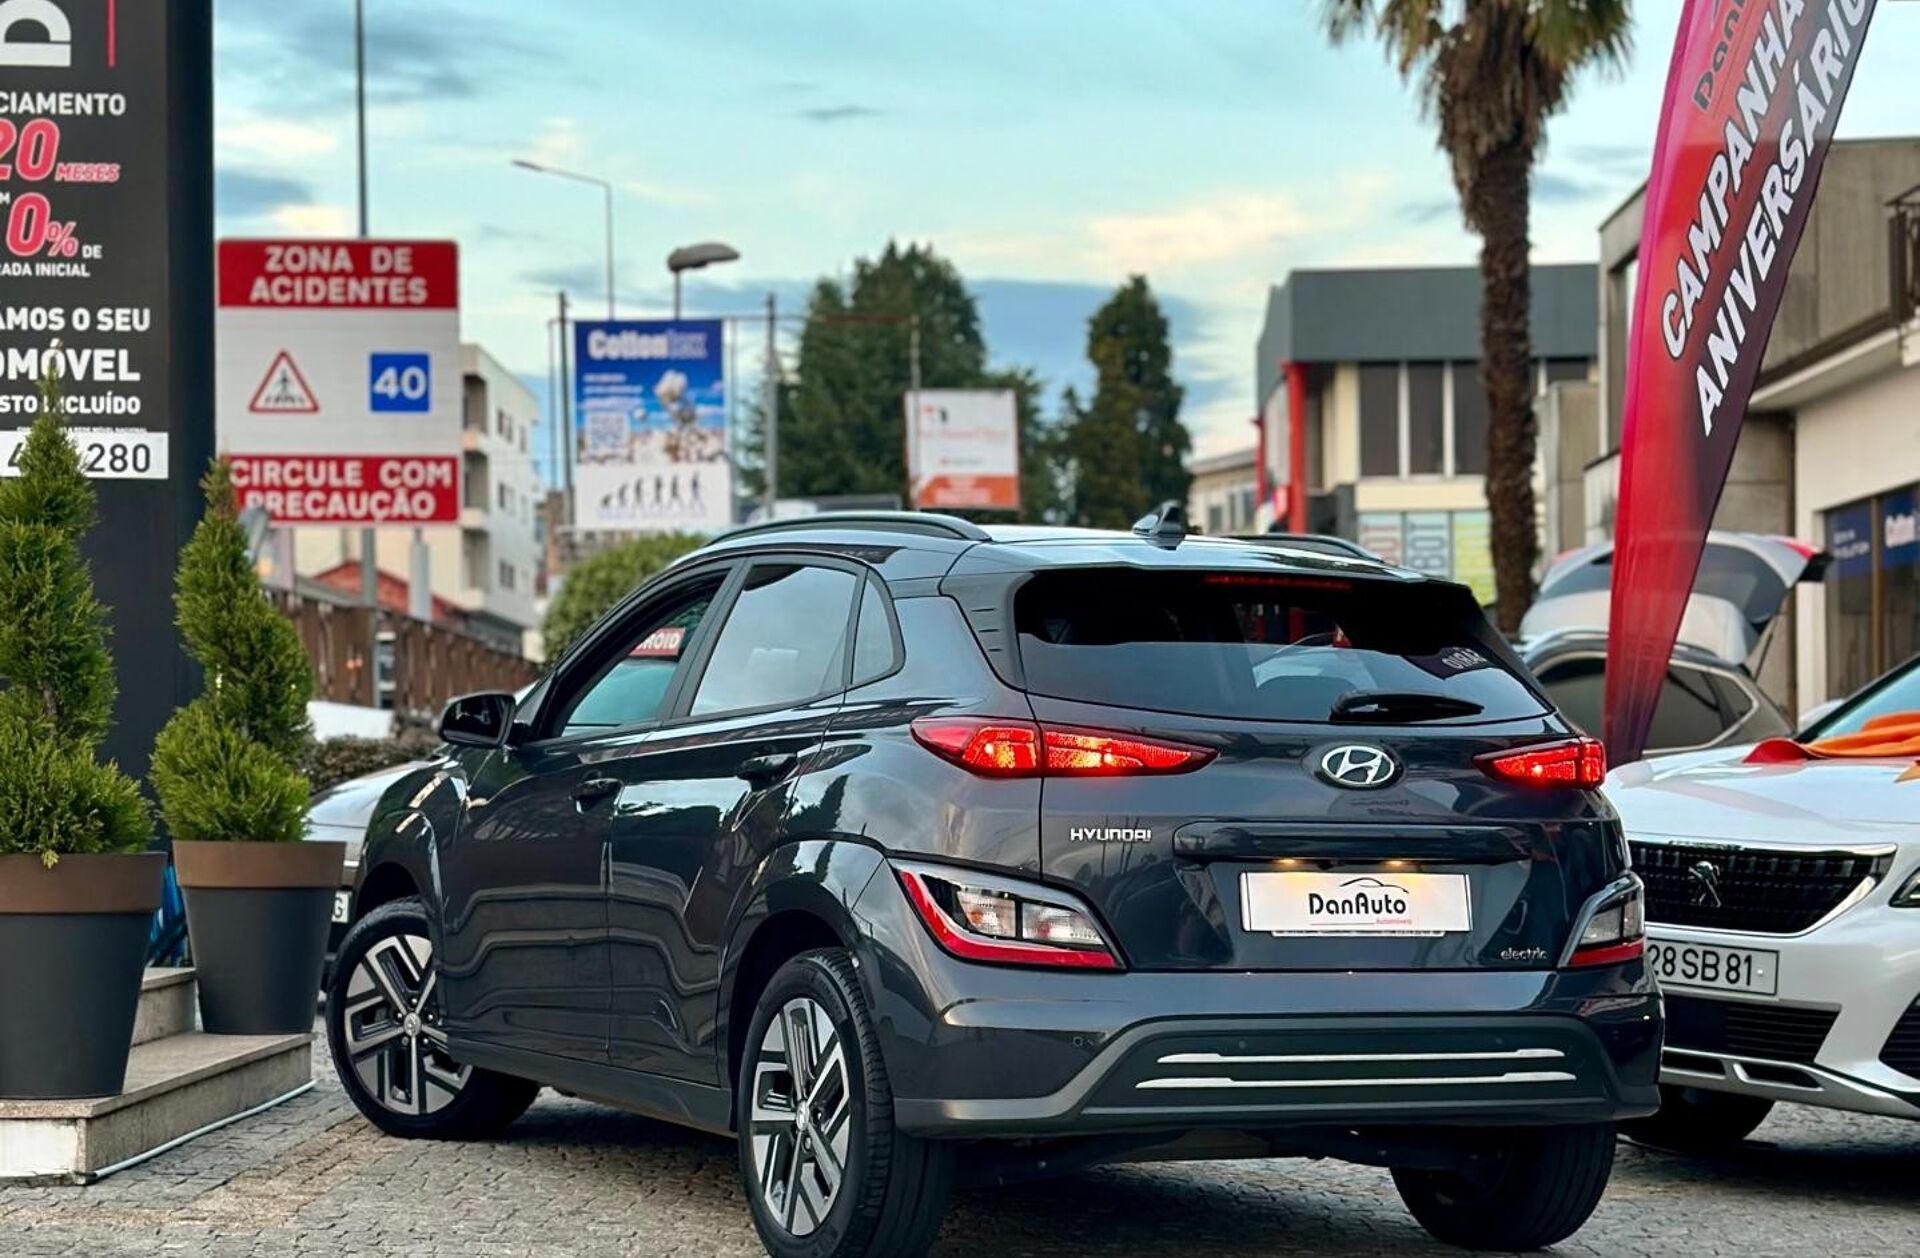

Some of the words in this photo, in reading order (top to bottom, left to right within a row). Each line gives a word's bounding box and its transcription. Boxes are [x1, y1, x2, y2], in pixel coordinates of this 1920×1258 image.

[1693, 0, 1748, 111] Dan
[55, 162, 121, 181] MESES
[1663, 0, 1805, 358] CAMPANHA
[82, 244, 102, 258] DE
[265, 246, 353, 273] ZONA
[371, 247, 413, 273] DE
[0, 262, 33, 276] ADA
[35, 263, 91, 277] INICIAL
[249, 276, 428, 303] ACIDENTES
[72, 308, 90, 332] O
[96, 308, 151, 332] SEU
[0, 337, 141, 381] MÓVEL
[373, 366, 427, 399] 40
[229, 459, 363, 488] CIRCULE
[379, 459, 451, 488] COM
[244, 487, 437, 522] PRECAUÇÃO
[1070, 827, 1152, 842] HYUNDAI
[1308, 892, 1407, 915] DanAuto
[1500, 946, 1549, 960] electric
[1647, 944, 1676, 977] 28
[1681, 948, 1720, 982] SB
[1725, 953, 1753, 986] 81
